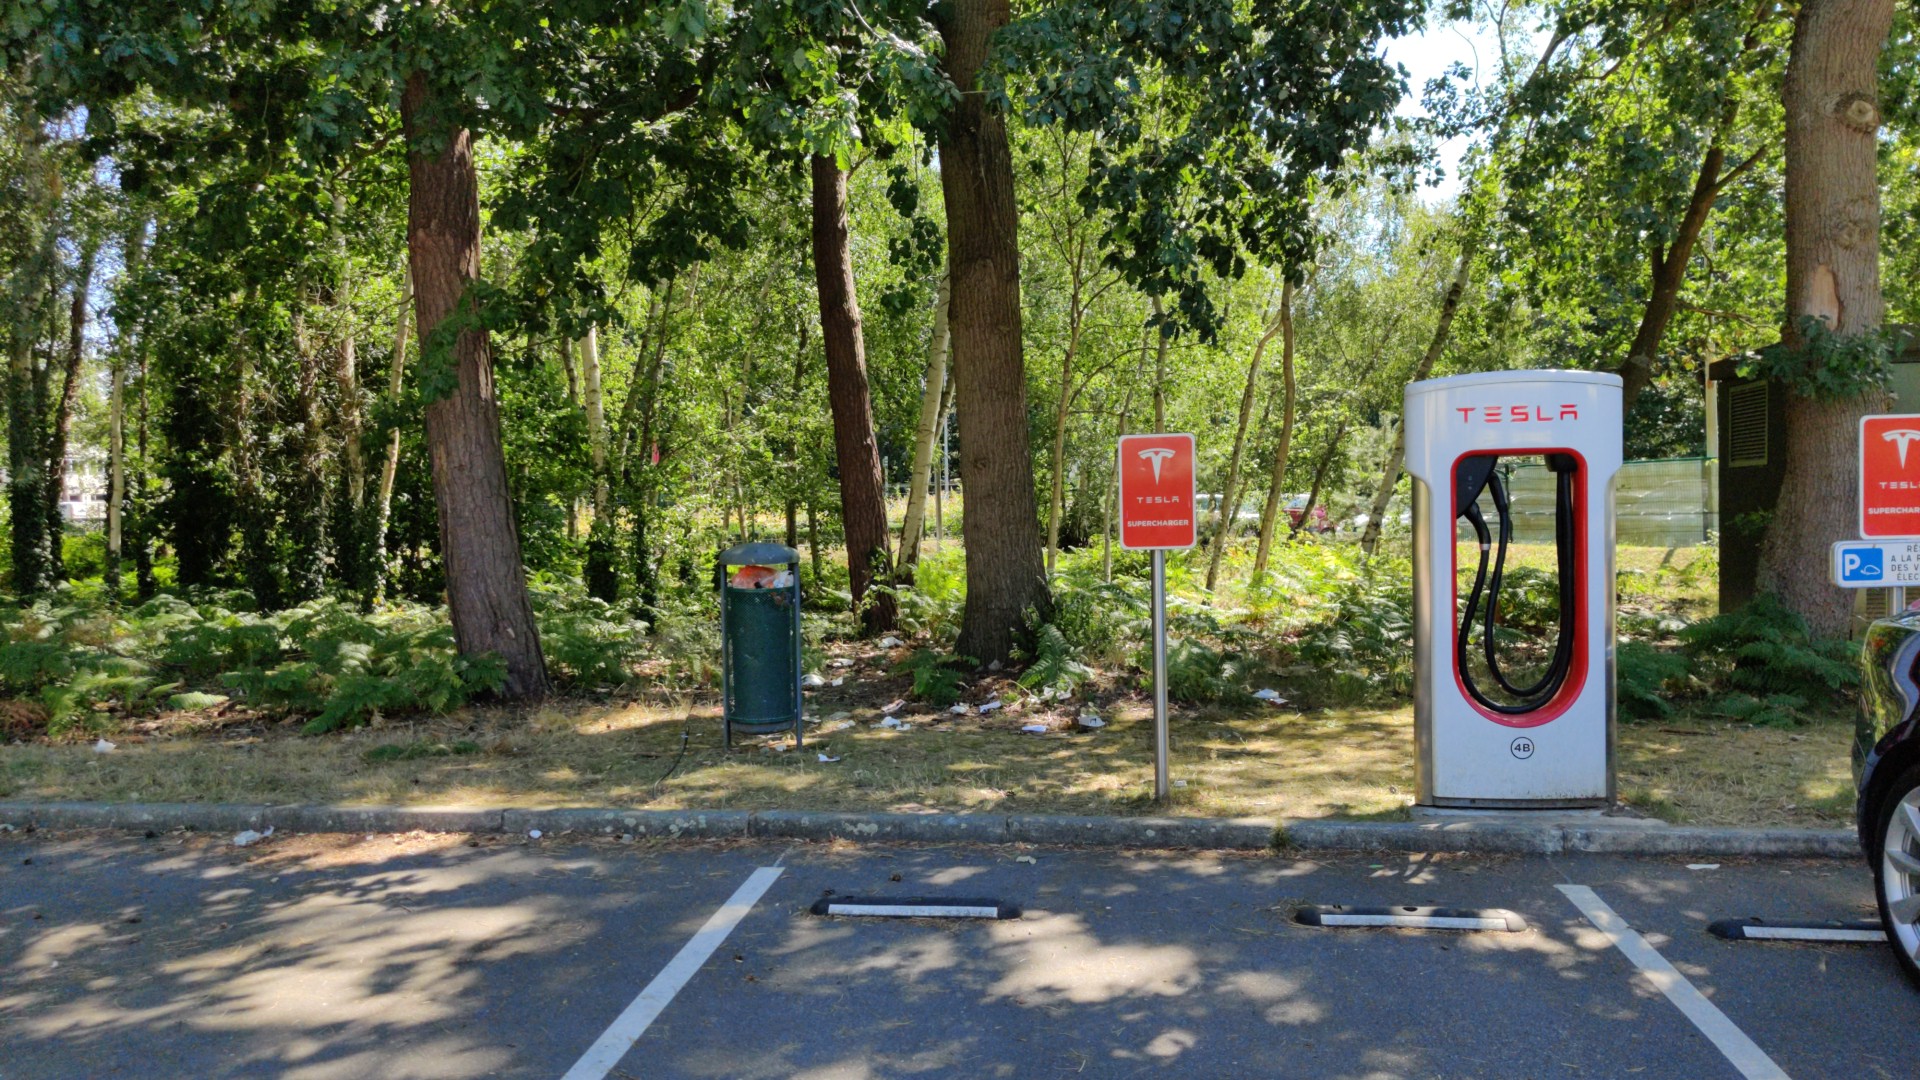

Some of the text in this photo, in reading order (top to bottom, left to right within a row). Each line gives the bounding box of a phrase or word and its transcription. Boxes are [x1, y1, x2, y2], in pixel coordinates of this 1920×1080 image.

[1456, 404, 1578, 424] TESLA
[1879, 481, 1920, 489] TESL
[1137, 496, 1179, 504] TESLA
[1127, 519, 1189, 527] SUPERCHARGER
[1901, 554, 1912, 562] LA
[1891, 564, 1909, 572] DES
[1514, 743, 1531, 752] 4B
